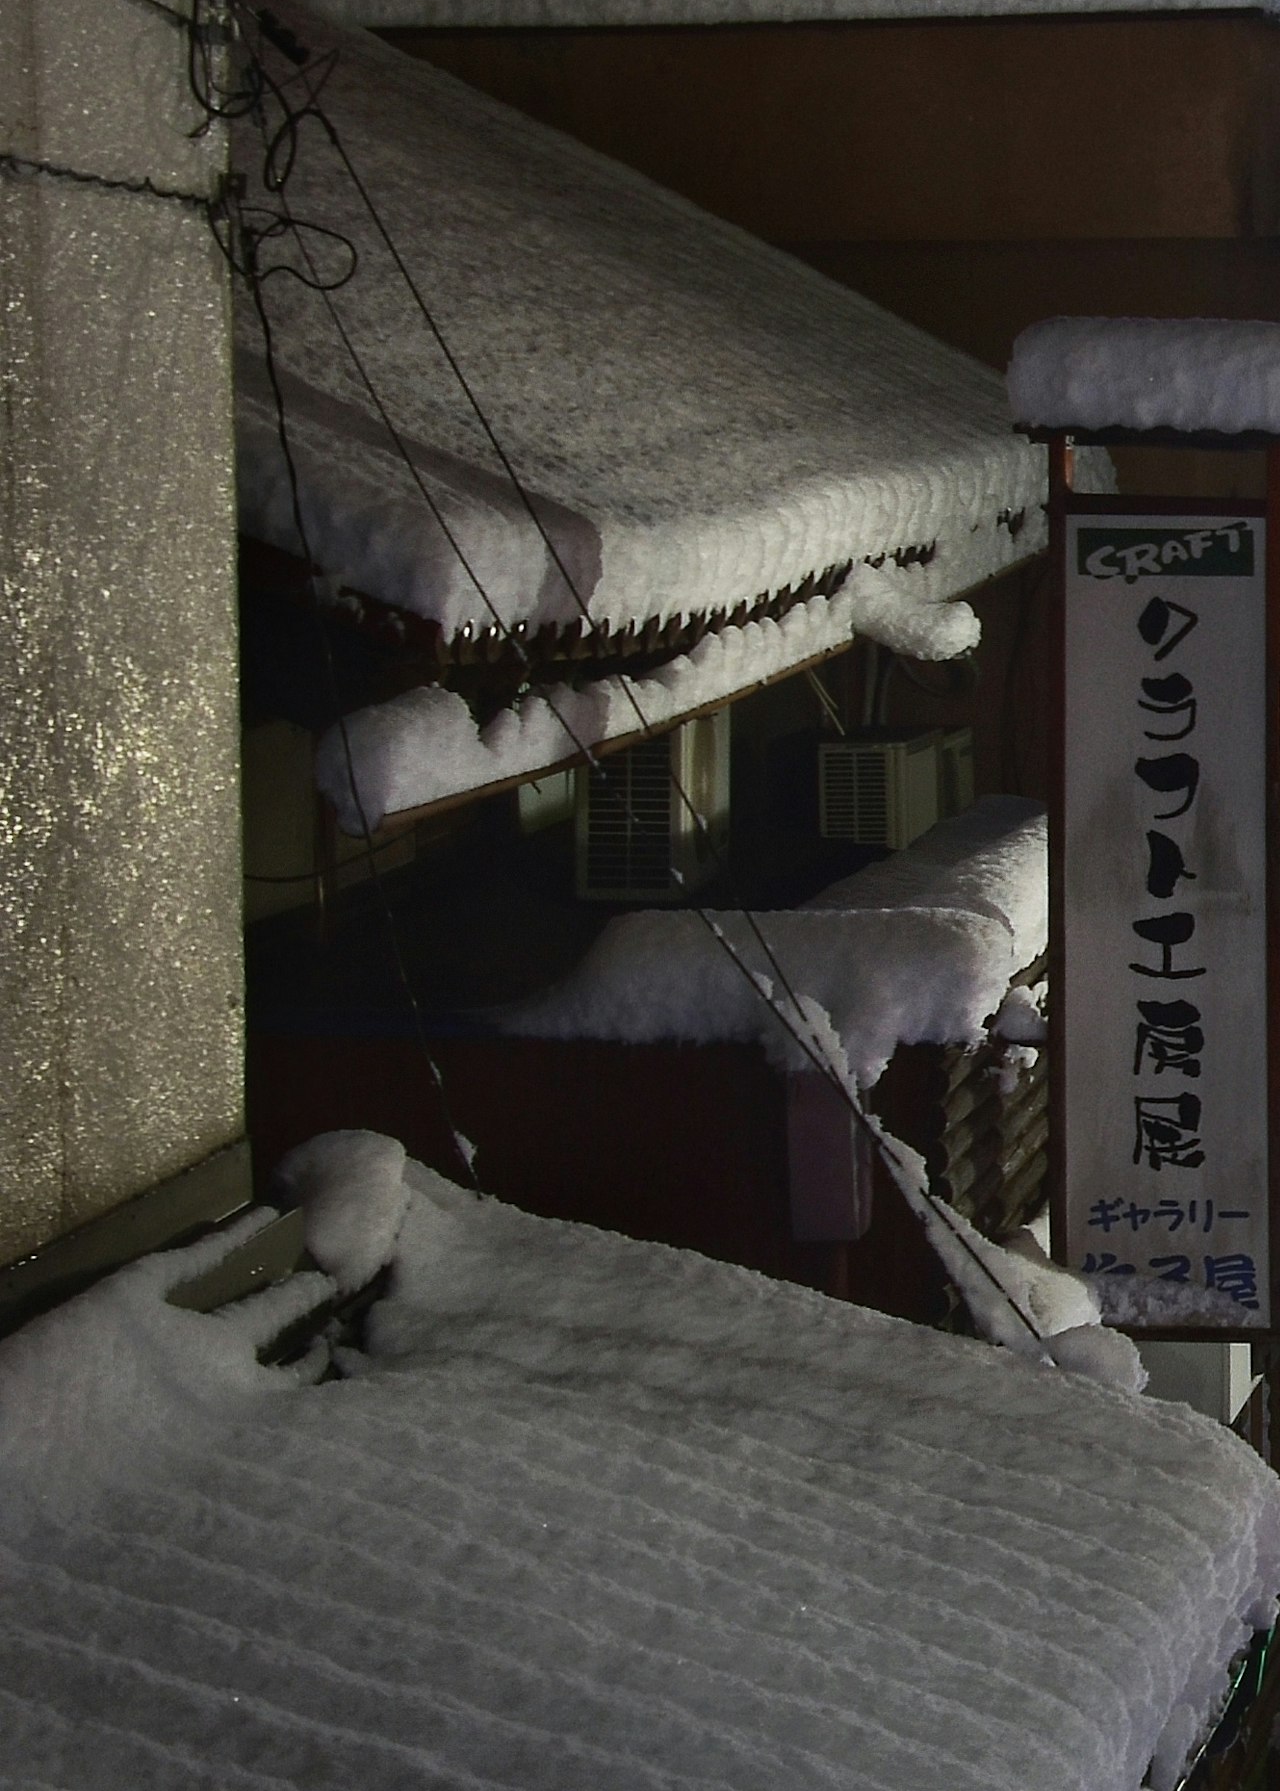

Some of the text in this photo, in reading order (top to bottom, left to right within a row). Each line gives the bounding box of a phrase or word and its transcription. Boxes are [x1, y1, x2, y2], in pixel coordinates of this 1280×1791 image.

[1085, 522, 1247, 584] CRAFT
[1088, 1198, 1249, 1232] ギャラリー
